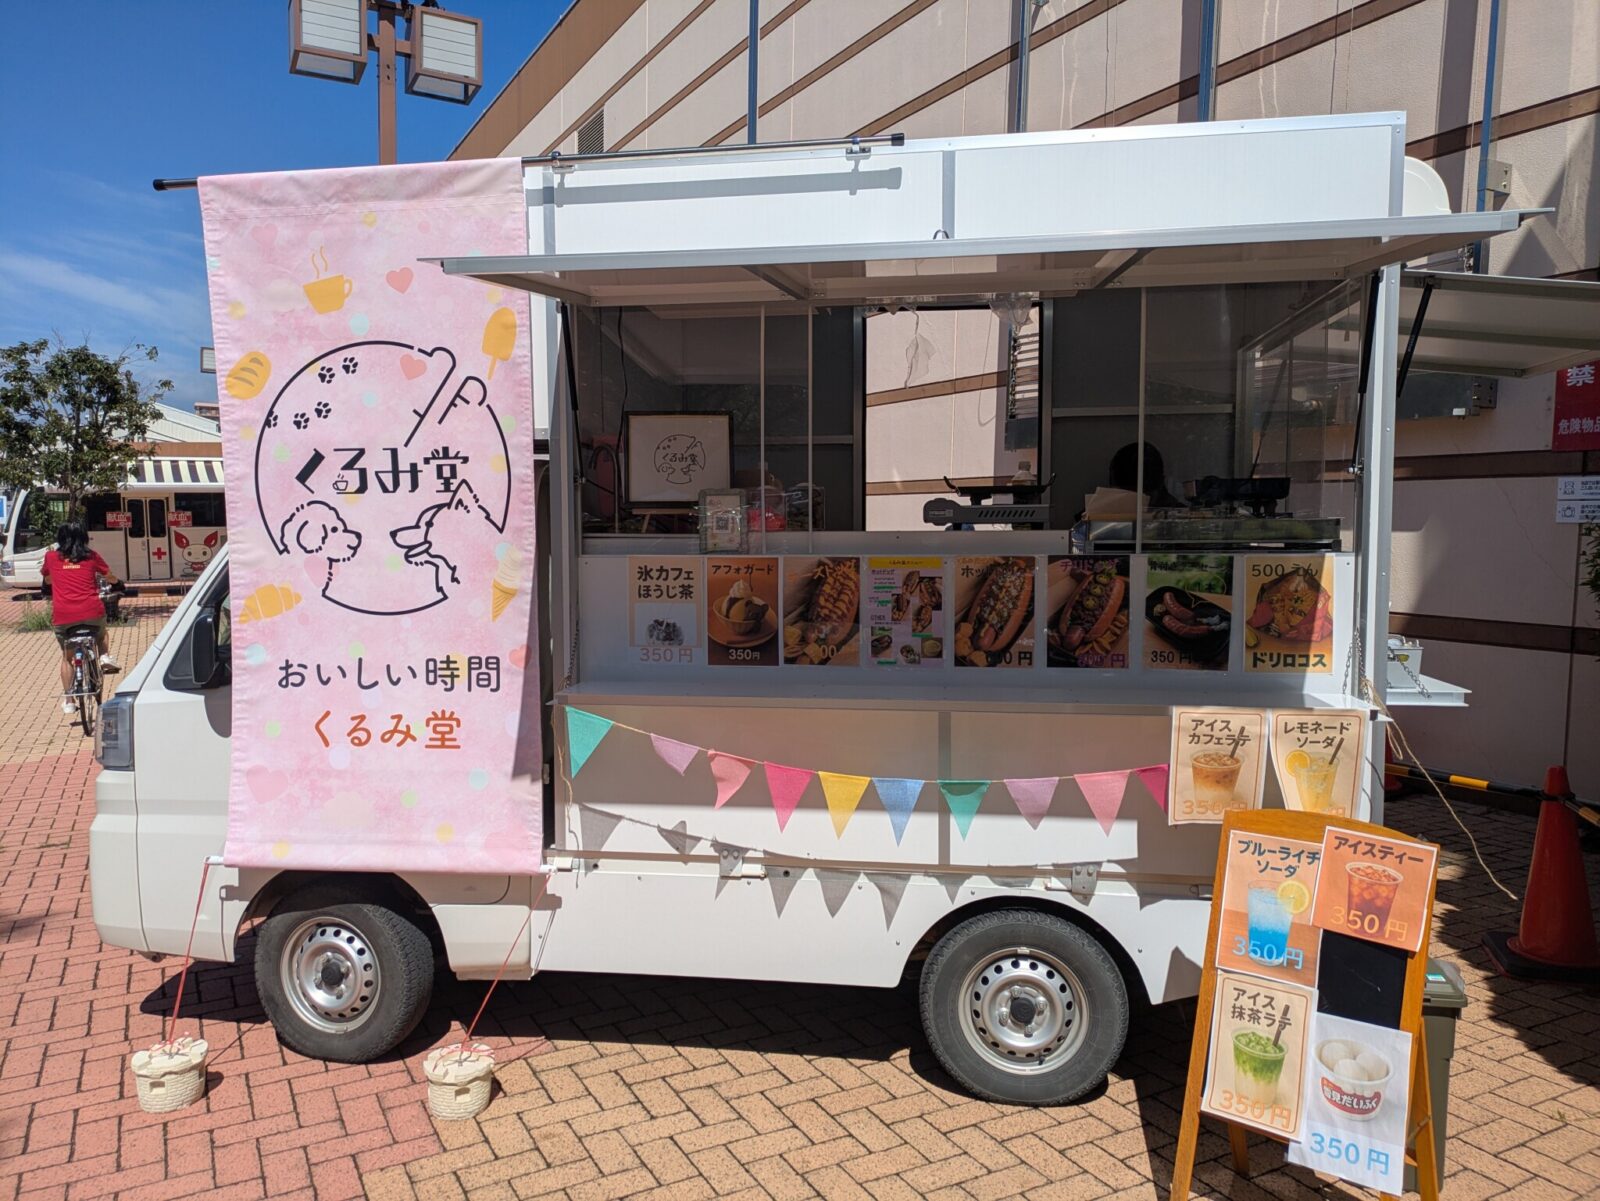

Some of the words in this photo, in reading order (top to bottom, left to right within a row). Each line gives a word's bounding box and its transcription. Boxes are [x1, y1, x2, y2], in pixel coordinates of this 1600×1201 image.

[1566, 365, 1595, 387] 禁
[661, 453, 698, 466] くるみ堂
[295, 446, 469, 495] くるみ堂
[637, 565, 695, 582] 氷カフェ
[711, 564, 774, 576] アフォガード
[1252, 564, 1285, 577] 500
[637, 583, 694, 599] ほうじ茶
[728, 649, 760, 661] 350円
[1252, 652, 1327, 668] ドリロコス
[278, 654, 501, 692] おいしい時間
[314, 709, 461, 749] くるみ堂
[1191, 719, 1231, 732] アイス
[1283, 721, 1351, 736] レモネード
[1188, 732, 1251, 747] カフェラテ
[1296, 737, 1336, 749] ソーダ
[1237, 839, 1320, 865] ブルーライチ
[1334, 835, 1424, 864] アイスティー
[1256, 860, 1300, 878] ソーダ
[1232, 987, 1276, 1011] アイス
[1231, 1004, 1292, 1031] 抹茶ラテ
[1323, 1086, 1378, 1109] 雪見だいふく
